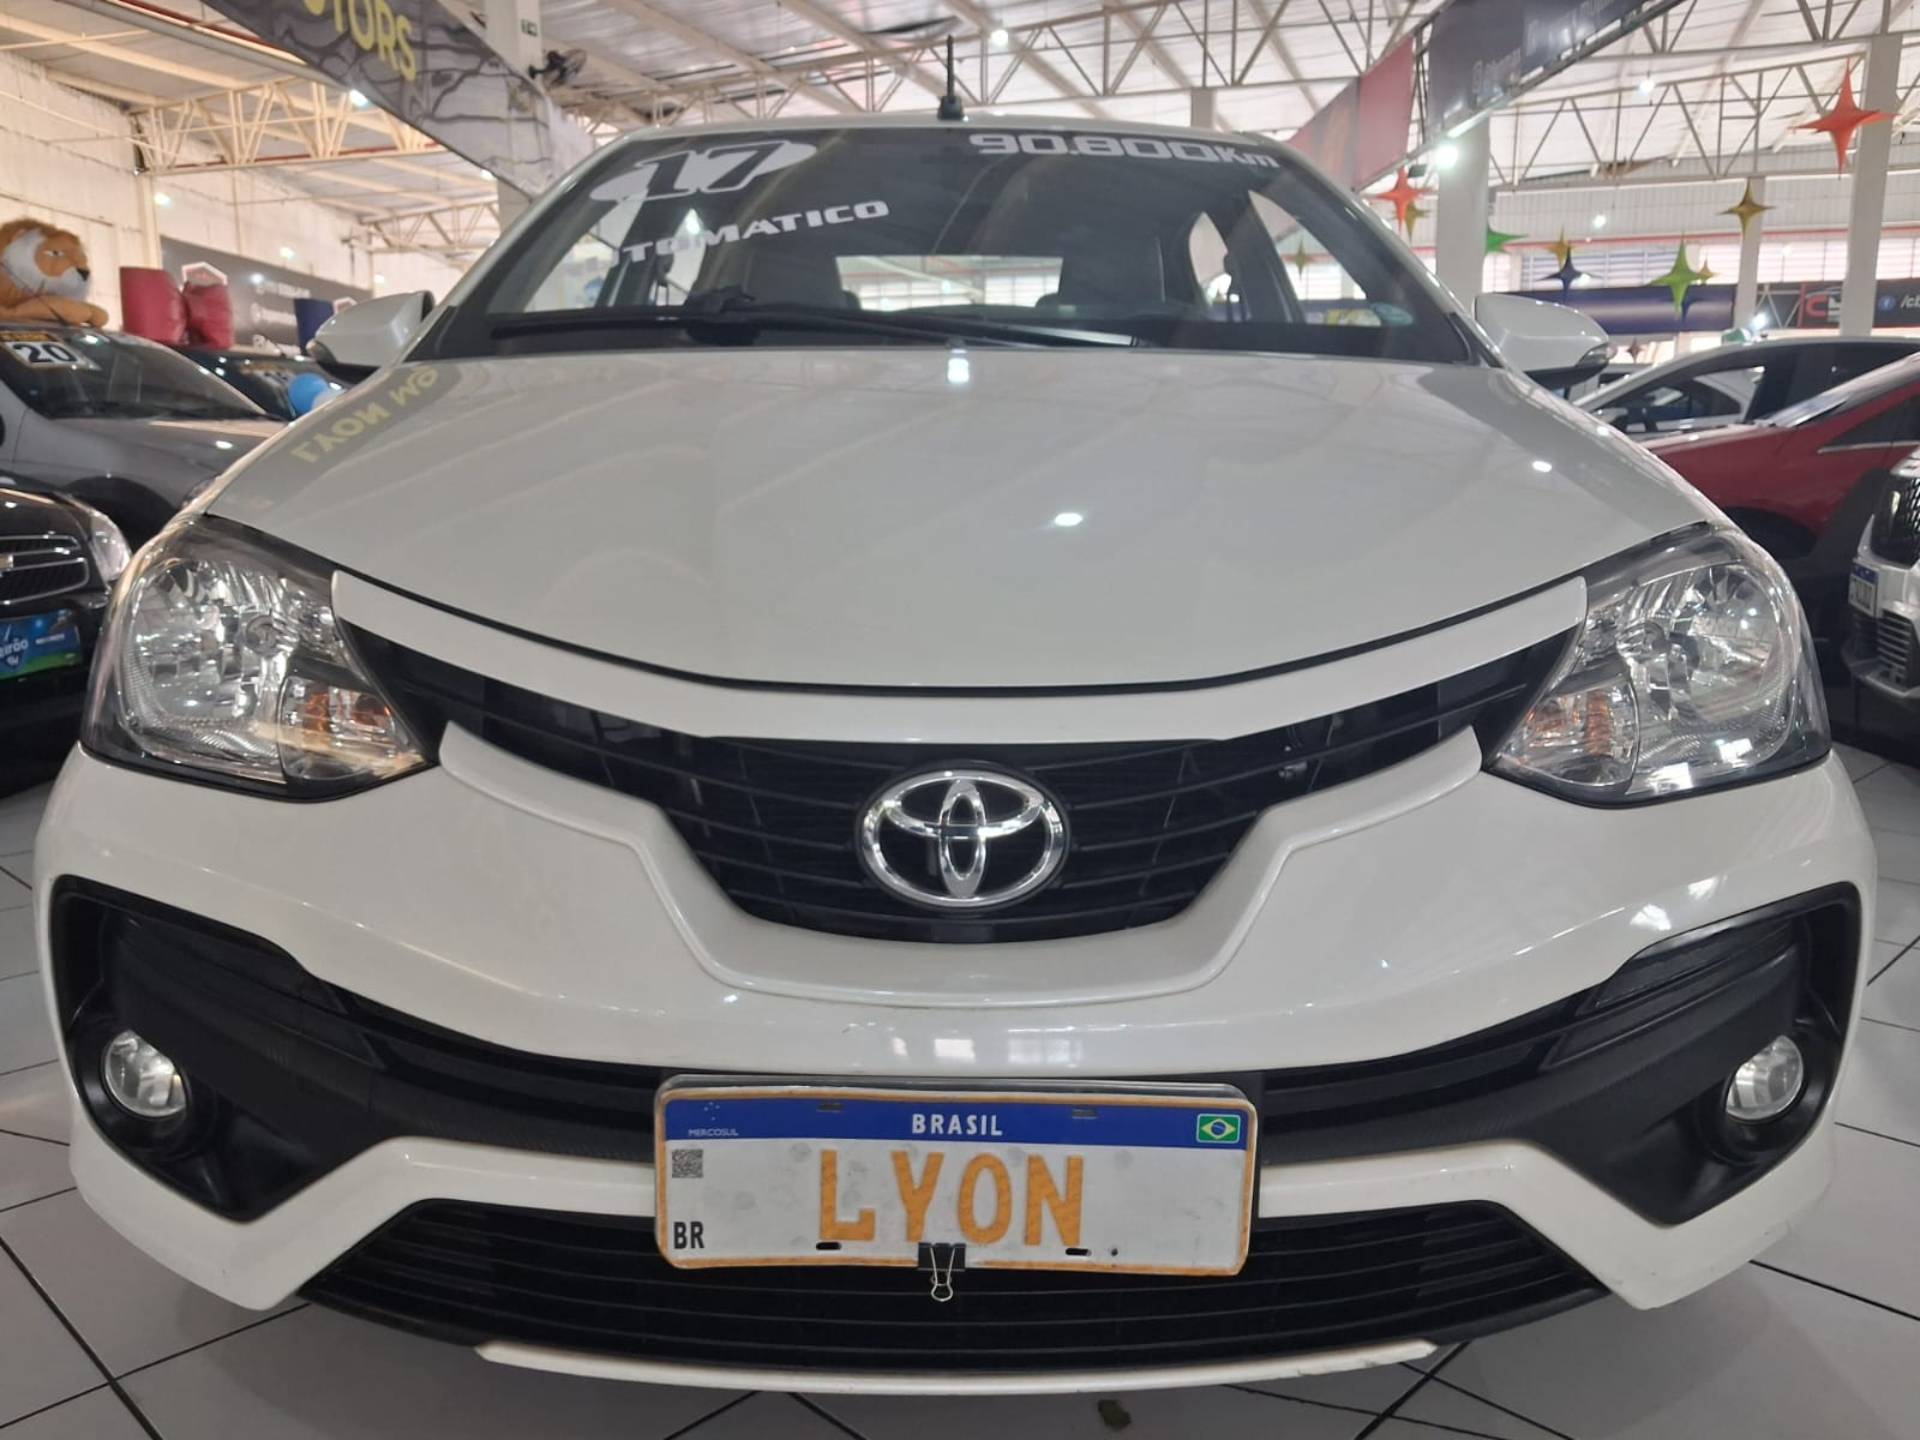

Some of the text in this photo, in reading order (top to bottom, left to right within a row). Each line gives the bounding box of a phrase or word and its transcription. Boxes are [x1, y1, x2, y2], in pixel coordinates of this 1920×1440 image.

[304, 0, 417, 81] ORS
[969, 133, 1280, 168] 90.800Km
[635, 140, 791, 200] 17
[612, 200, 890, 267] TOMATICO
[13, 344, 78, 362] 20
[687, 1128, 739, 1137] MERCOSUL
[911, 1113, 1003, 1137] BRASIL
[819, 1150, 1084, 1245] LYON
[673, 1221, 705, 1250] BR
